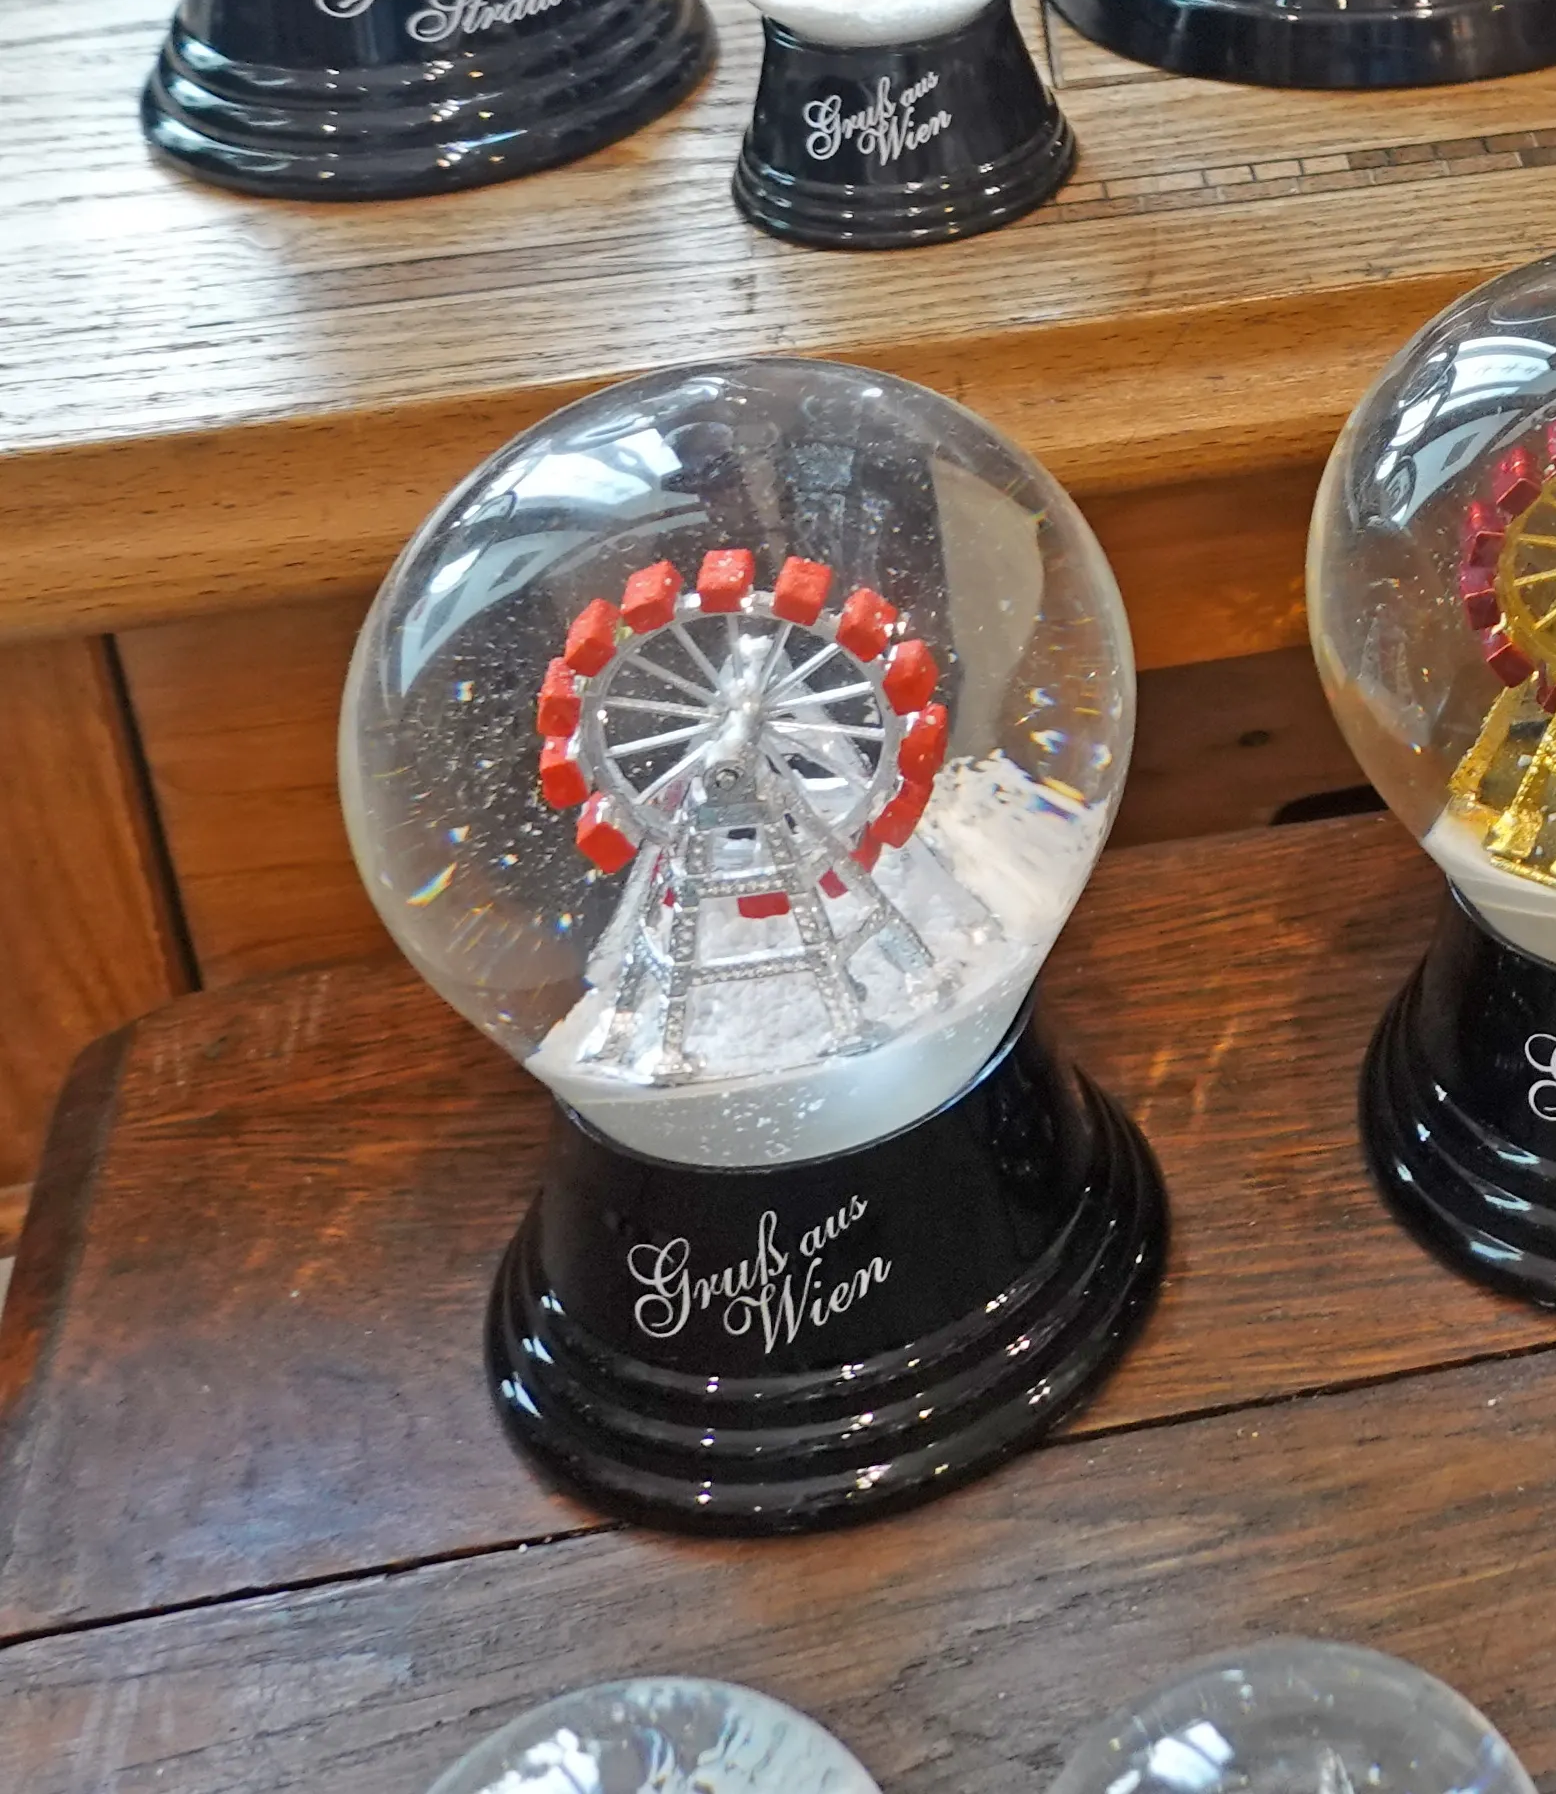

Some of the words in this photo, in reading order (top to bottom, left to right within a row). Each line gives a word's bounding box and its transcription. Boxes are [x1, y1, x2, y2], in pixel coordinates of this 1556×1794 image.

[803, 76, 897, 160] Gruß
[900, 71, 940, 107] aus
[857, 106, 952, 167] Wien
[627, 1210, 789, 1338] Gruß
[799, 1195, 868, 1256] aus
[723, 1257, 892, 1354] Wien
